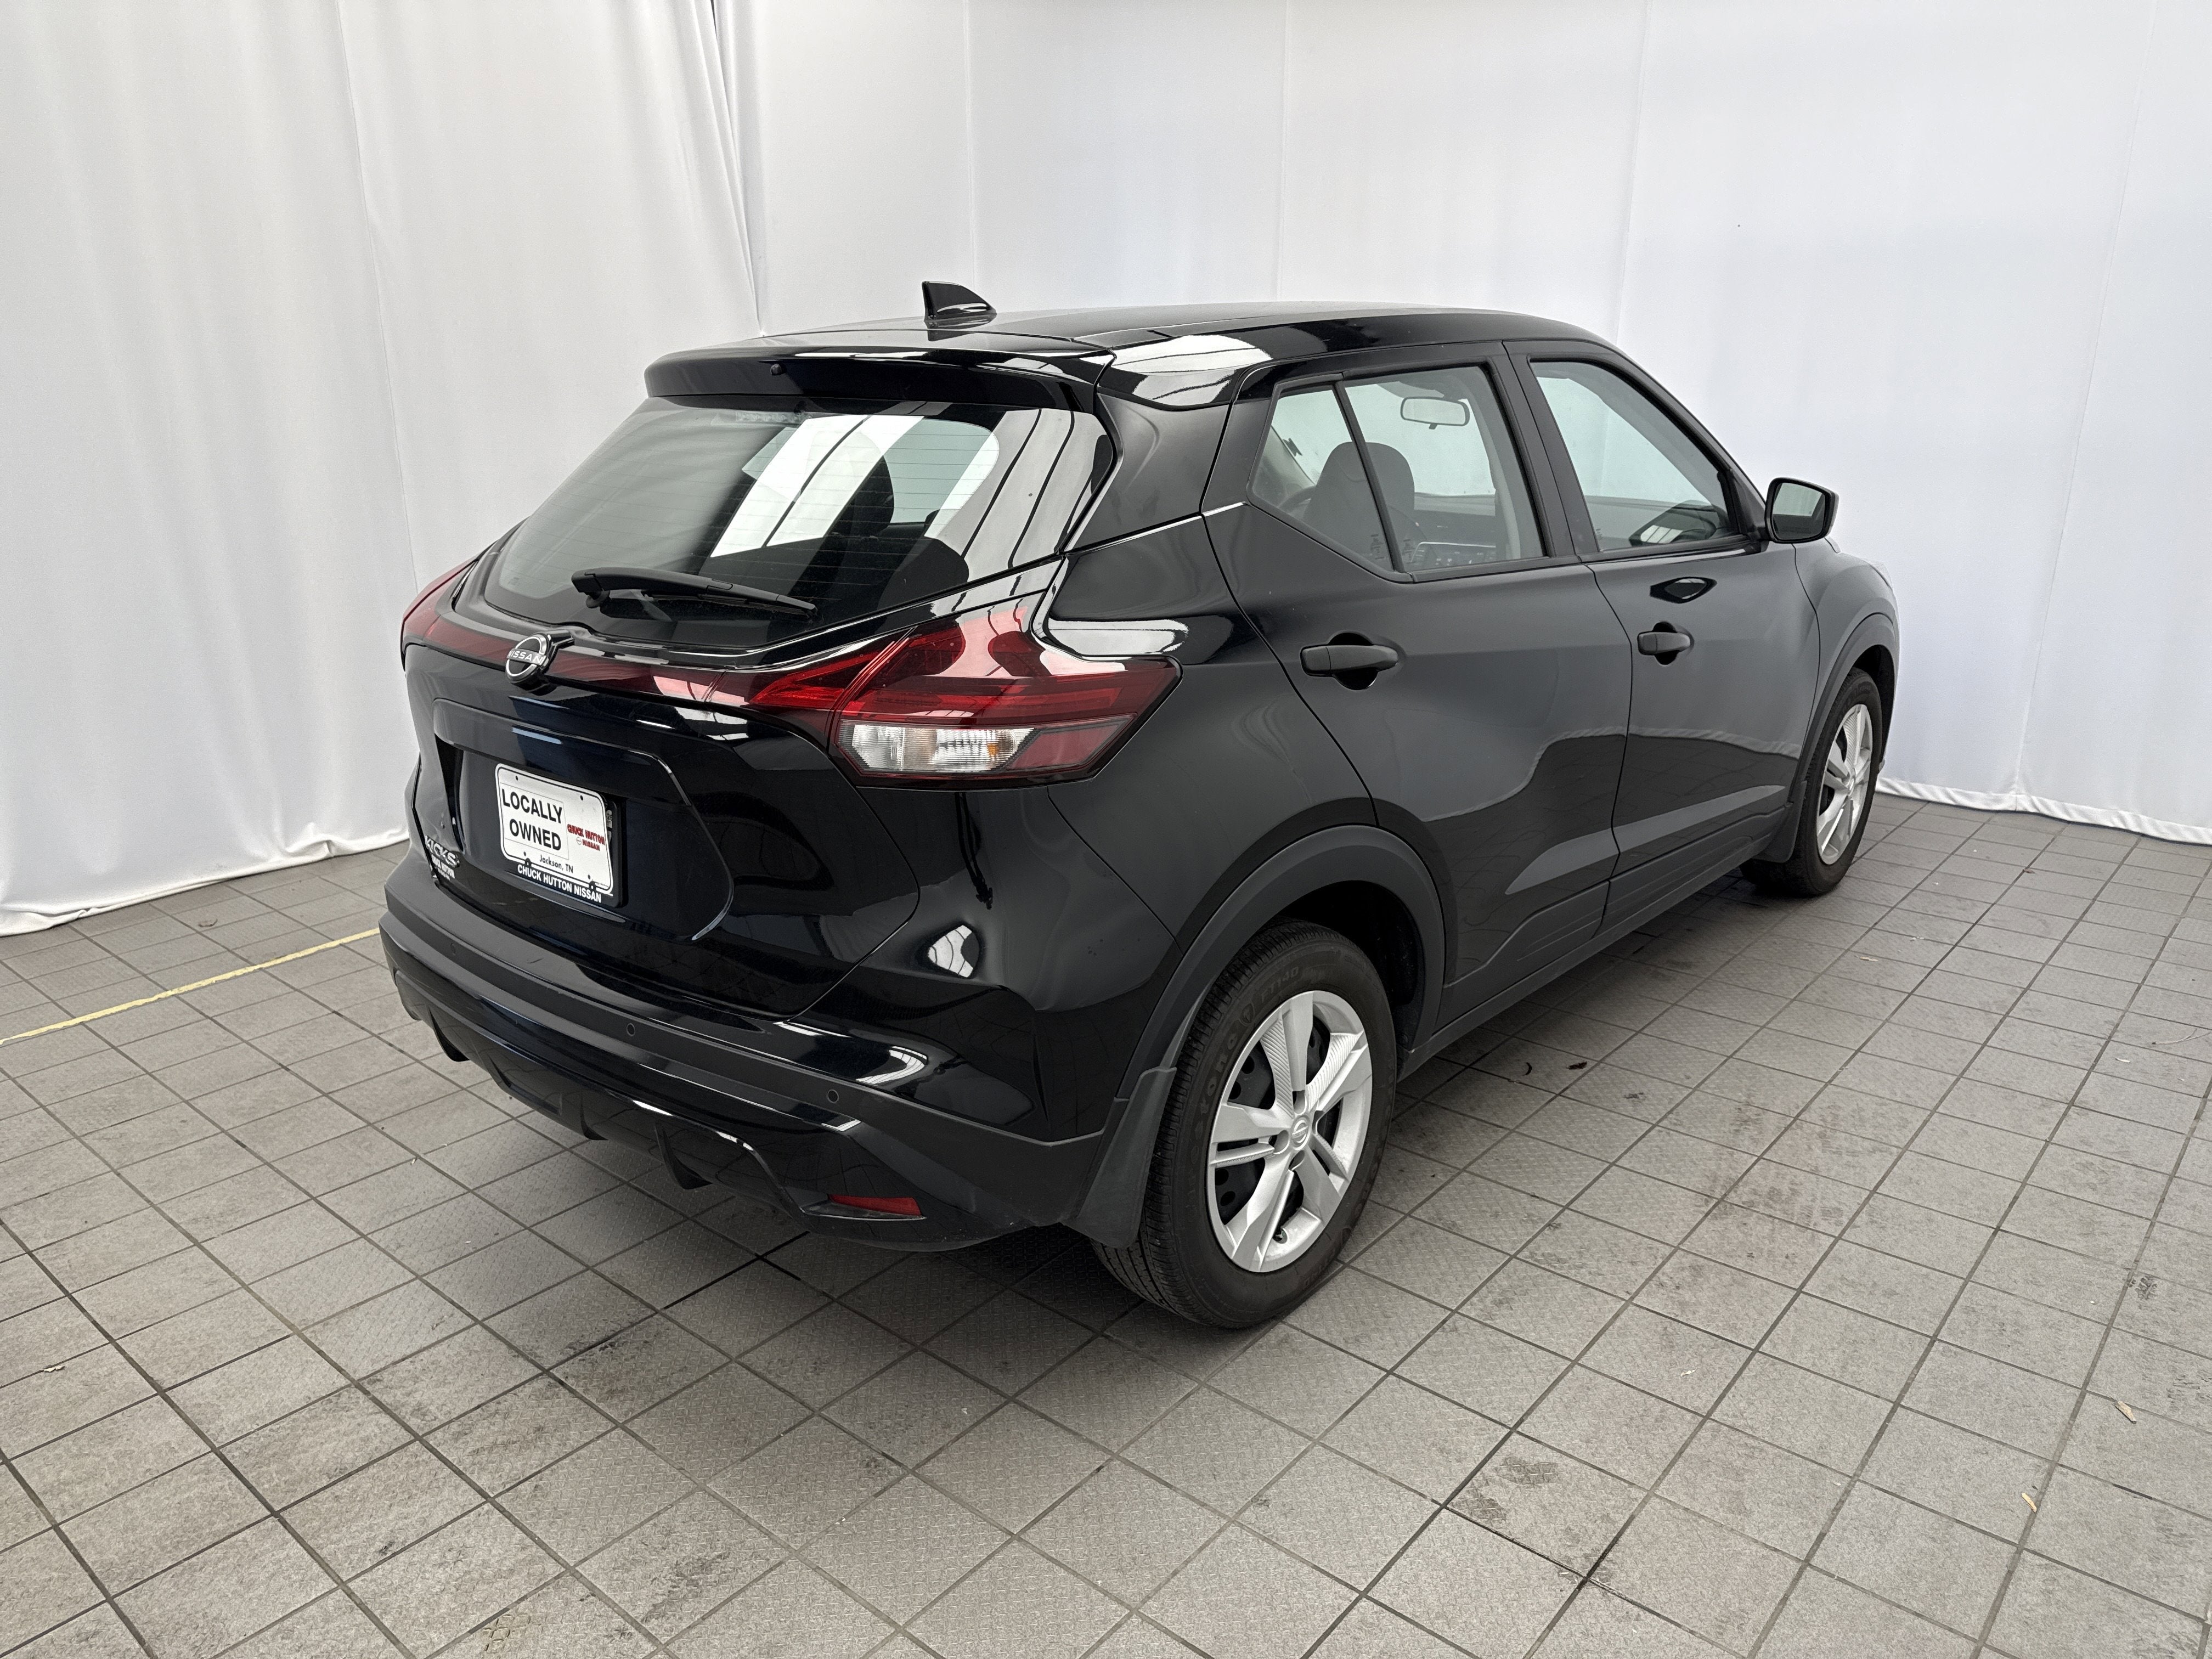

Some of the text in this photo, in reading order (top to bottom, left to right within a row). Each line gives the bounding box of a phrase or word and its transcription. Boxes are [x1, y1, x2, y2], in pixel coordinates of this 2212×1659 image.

[507, 650, 545, 664] NISSAN
[501, 788, 562, 823] LOCALLY
[510, 819, 561, 850] OWNED
[425, 835, 458, 867] KICKS
[539, 855, 574, 873] Jackson, TN
[517, 864, 601, 903] CHUCK HUTTON NISSAN
